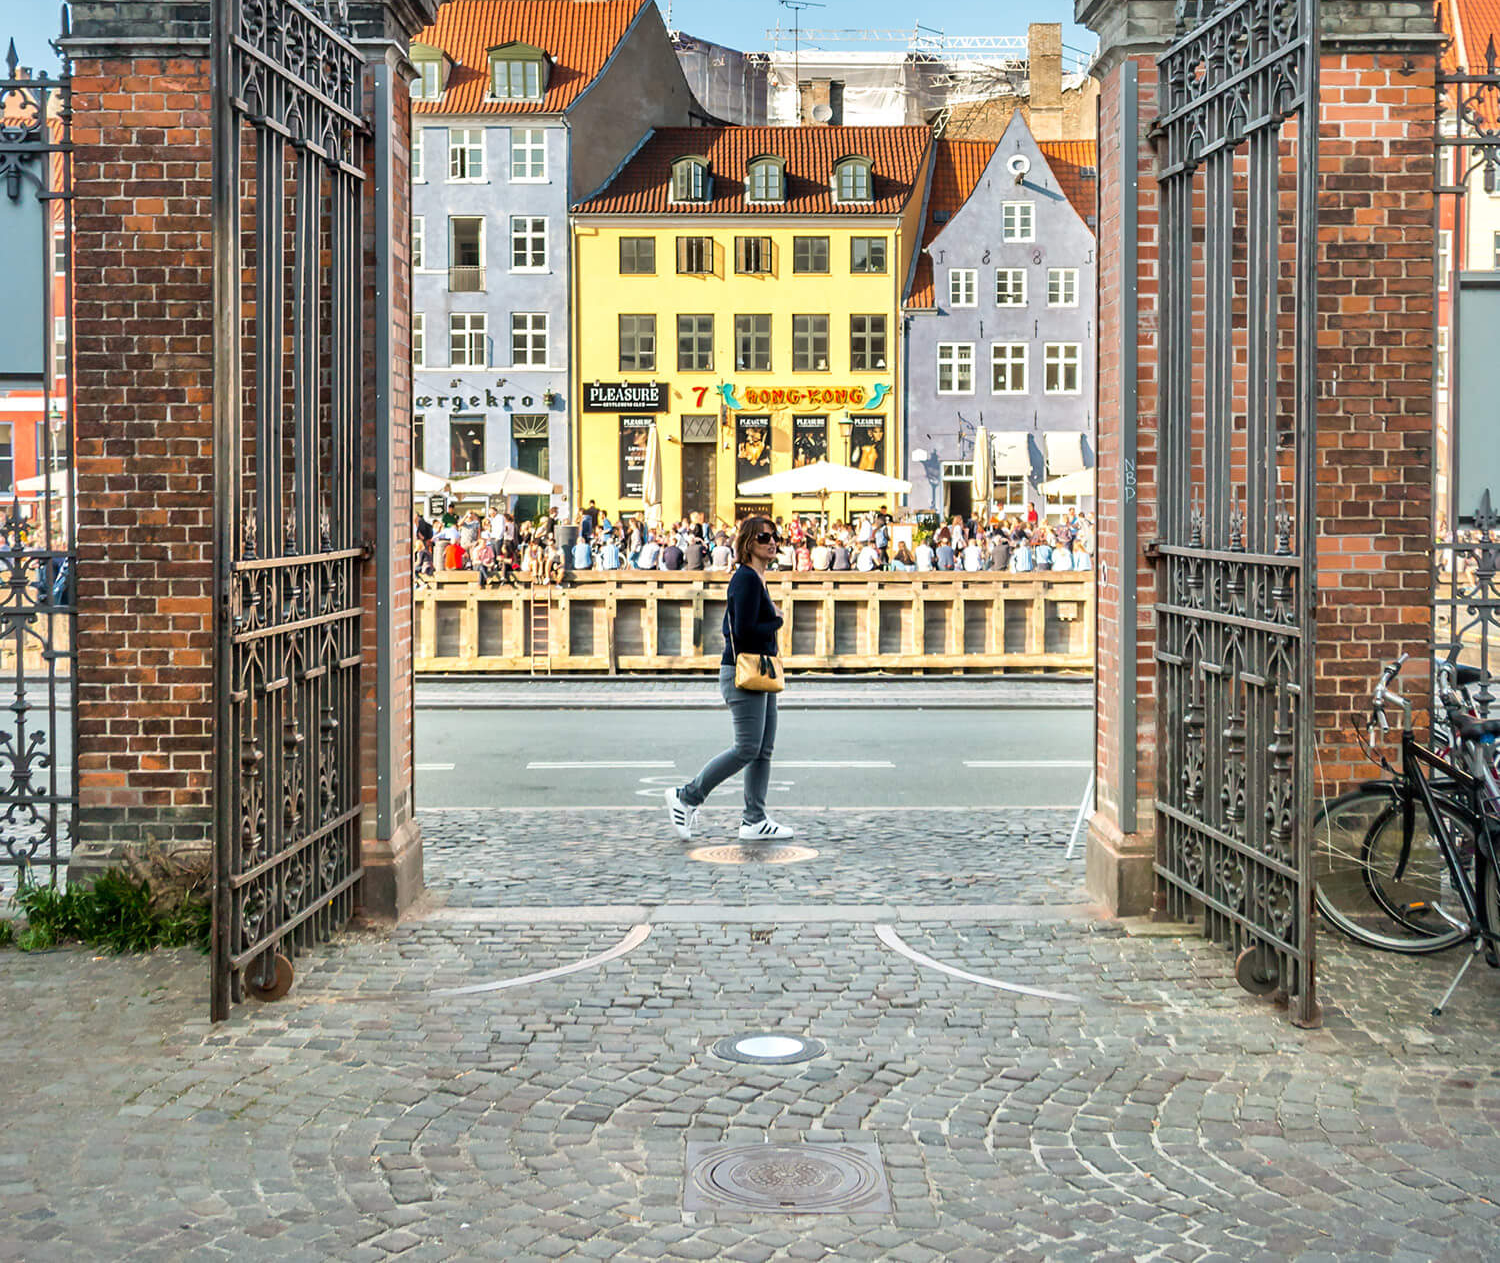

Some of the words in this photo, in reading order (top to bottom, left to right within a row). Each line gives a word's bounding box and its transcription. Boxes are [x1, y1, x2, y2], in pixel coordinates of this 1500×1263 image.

[416, 389, 534, 413] ærgekro
[590, 388, 659, 401] PLEASURE
[692, 387, 709, 408] 7
[746, 389, 863, 405] HONG-KONG
